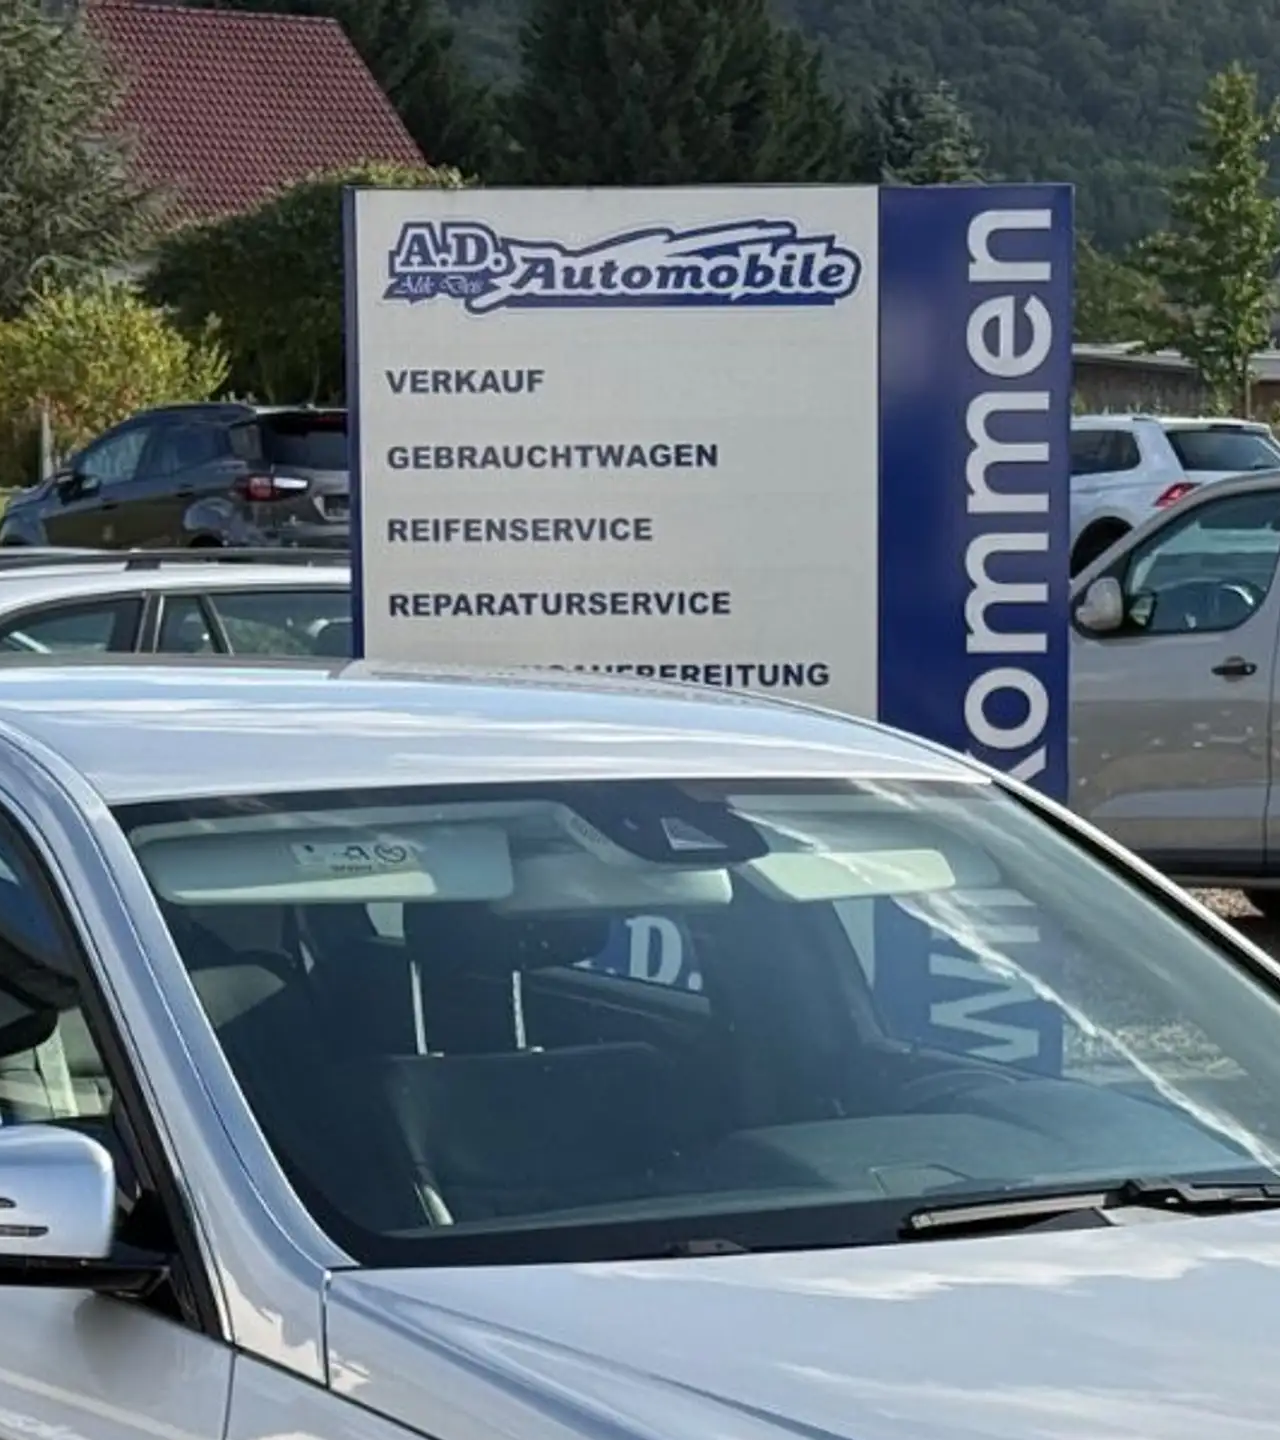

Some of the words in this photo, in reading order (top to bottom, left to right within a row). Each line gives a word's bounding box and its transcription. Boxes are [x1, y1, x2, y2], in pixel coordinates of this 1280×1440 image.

[399, 232, 505, 269] A.D.
[511, 249, 847, 293] Automobile
[384, 369, 546, 394] VERKAUF
[386, 444, 719, 470] GEBRAUCHTWAGEN
[387, 517, 654, 542] REIFENSERVICE
[388, 591, 733, 617] REPARATURSERVICE
